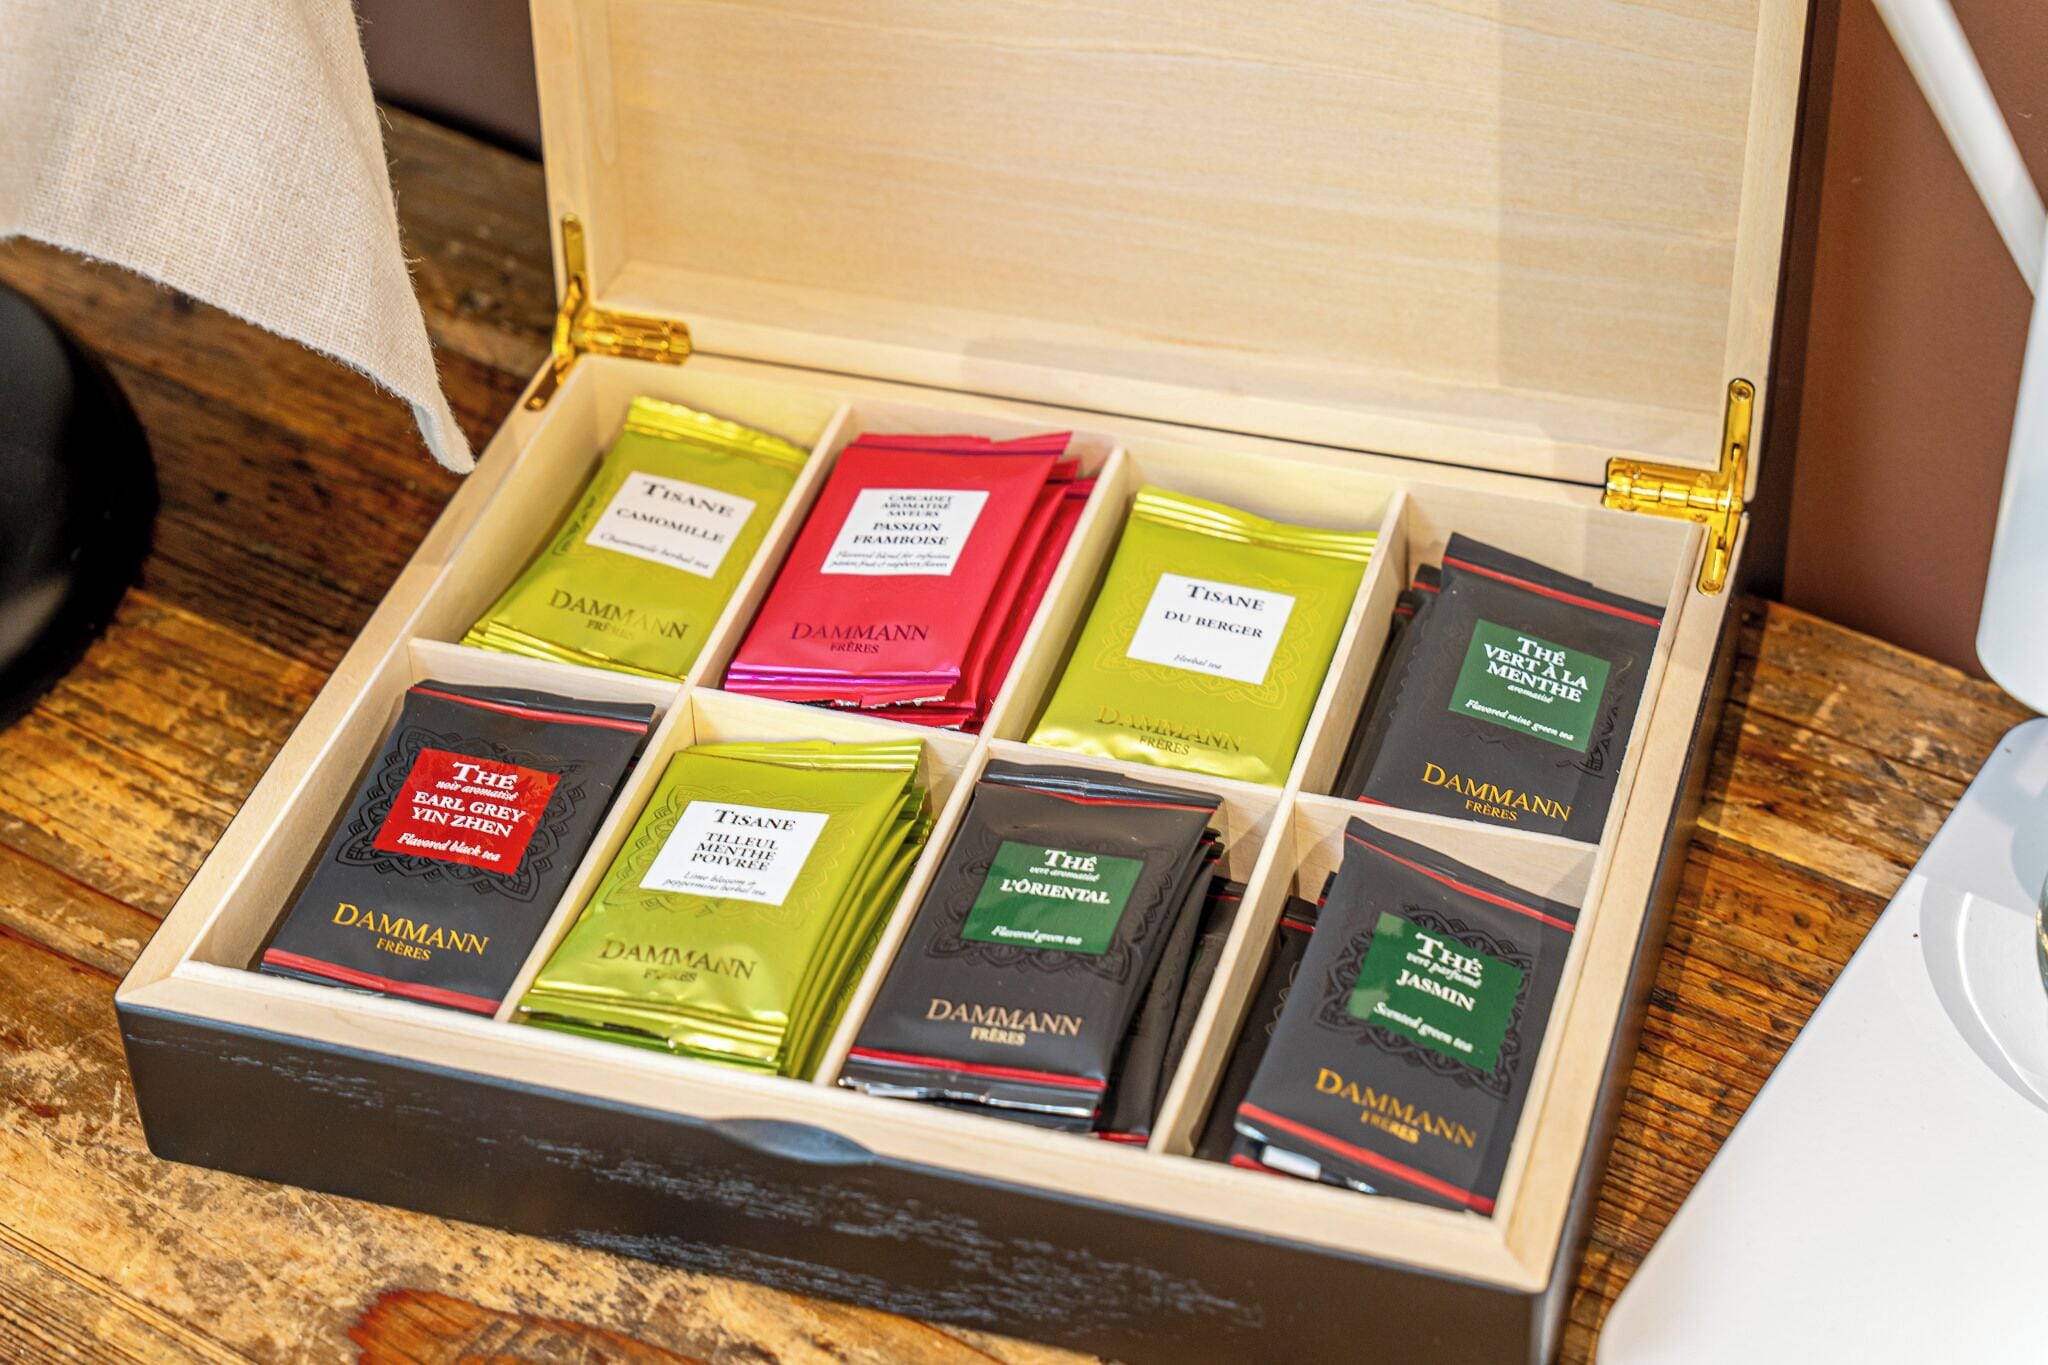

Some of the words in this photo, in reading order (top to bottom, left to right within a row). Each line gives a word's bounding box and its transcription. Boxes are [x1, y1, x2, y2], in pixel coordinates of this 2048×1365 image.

[642, 480, 735, 518] TISANE
[616, 507, 726, 544] CAMOMILLE
[852, 535, 950, 546] FRAMBOISE
[872, 521, 943, 532] PASSION
[549, 588, 688, 640] DAMMANN
[1187, 583, 1265, 612] TISANE
[790, 621, 930, 642] DAMMANN
[1164, 610, 1191, 624] DU
[1195, 616, 1264, 639] BERGER
[1483, 643, 1541, 673] VERT
[1561, 669, 1589, 691] LA
[1486, 660, 1582, 703] MENTHE
[1464, 698, 1509, 719] Flavored
[1507, 713, 1532, 726] mint
[1530, 722, 1558, 736] green
[1559, 731, 1575, 741] tea
[435, 780, 461, 792] noir
[1421, 761, 1573, 822] DAMMANN
[411, 791, 466, 812] EARL
[469, 801, 526, 824] GREY
[411, 806, 450, 826] YIN
[450, 814, 514, 838] ZHEN
[714, 808, 796, 832] TISANE
[1465, 799, 1518, 822] FRÈRES
[397, 832, 450, 852] Flavored
[450, 841, 482, 859] black
[481, 849, 502, 862] tea
[697, 842, 777, 862] MENTHE
[705, 831, 779, 851] TILLEUL
[332, 902, 490, 956] DAMMANN
[376, 937, 432, 961] FRÈRES
[598, 938, 758, 981] DAMMANN
[1396, 968, 1476, 1012] JASMIN
[925, 997, 1083, 1038] DAMMANN
[1372, 1001, 1424, 1030] Scented
[1416, 1022, 1454, 1045] green
[1315, 1066, 1478, 1149] DAMMANN
